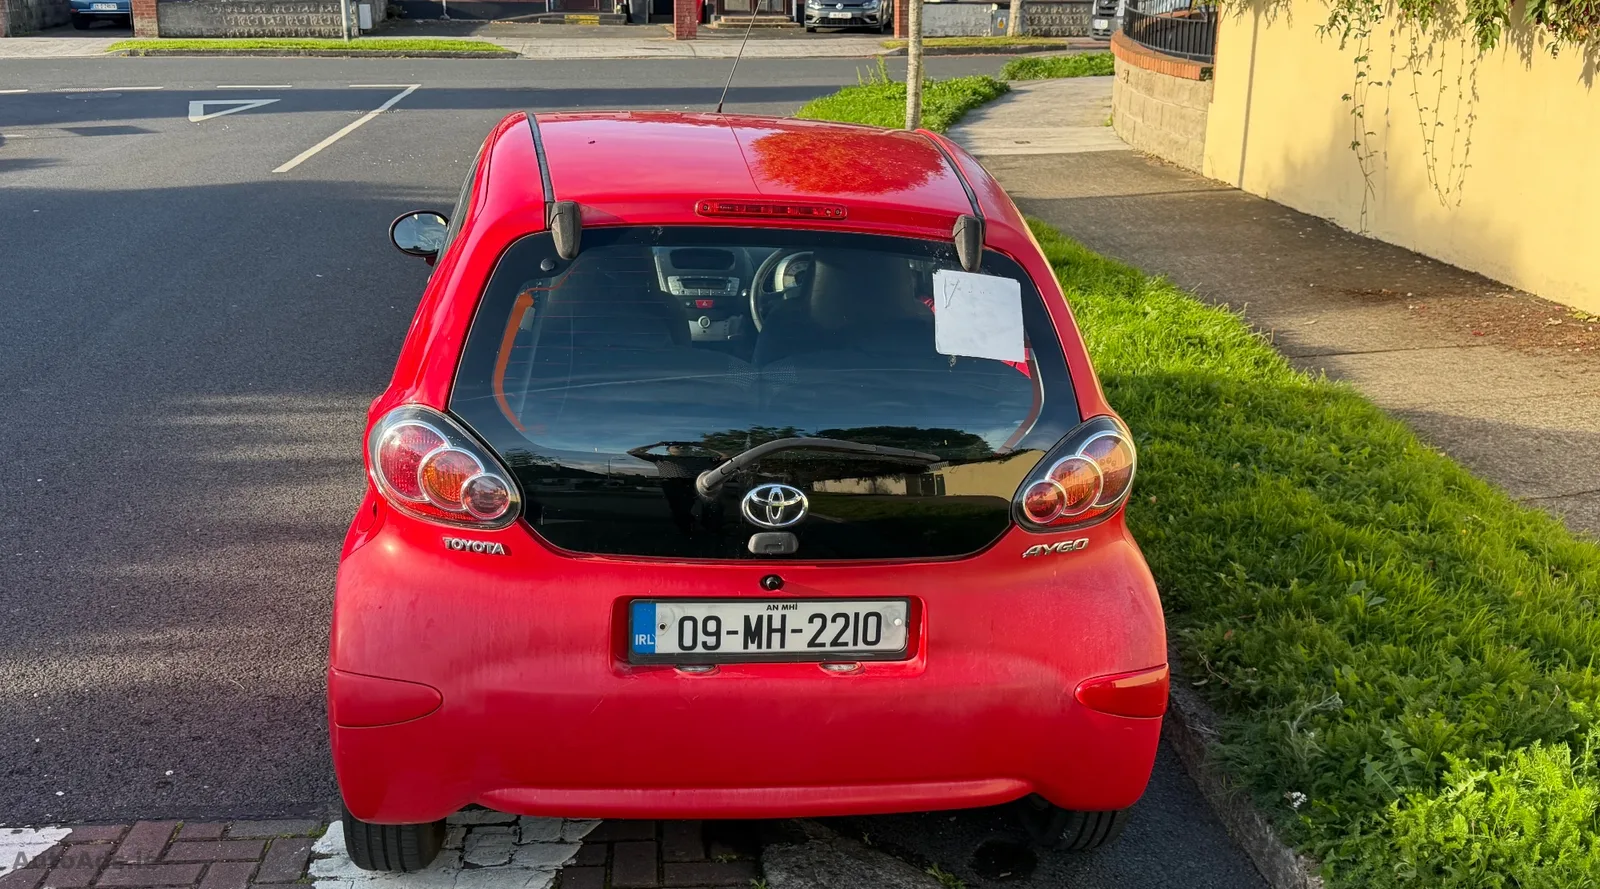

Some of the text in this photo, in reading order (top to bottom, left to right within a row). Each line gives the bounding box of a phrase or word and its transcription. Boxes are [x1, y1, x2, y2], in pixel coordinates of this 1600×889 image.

[442, 536, 506, 555] TOYOTA
[1022, 537, 1089, 558] AYGO
[635, 633, 655, 646] IRL
[677, 611, 882, 651] 09-MH-2210
